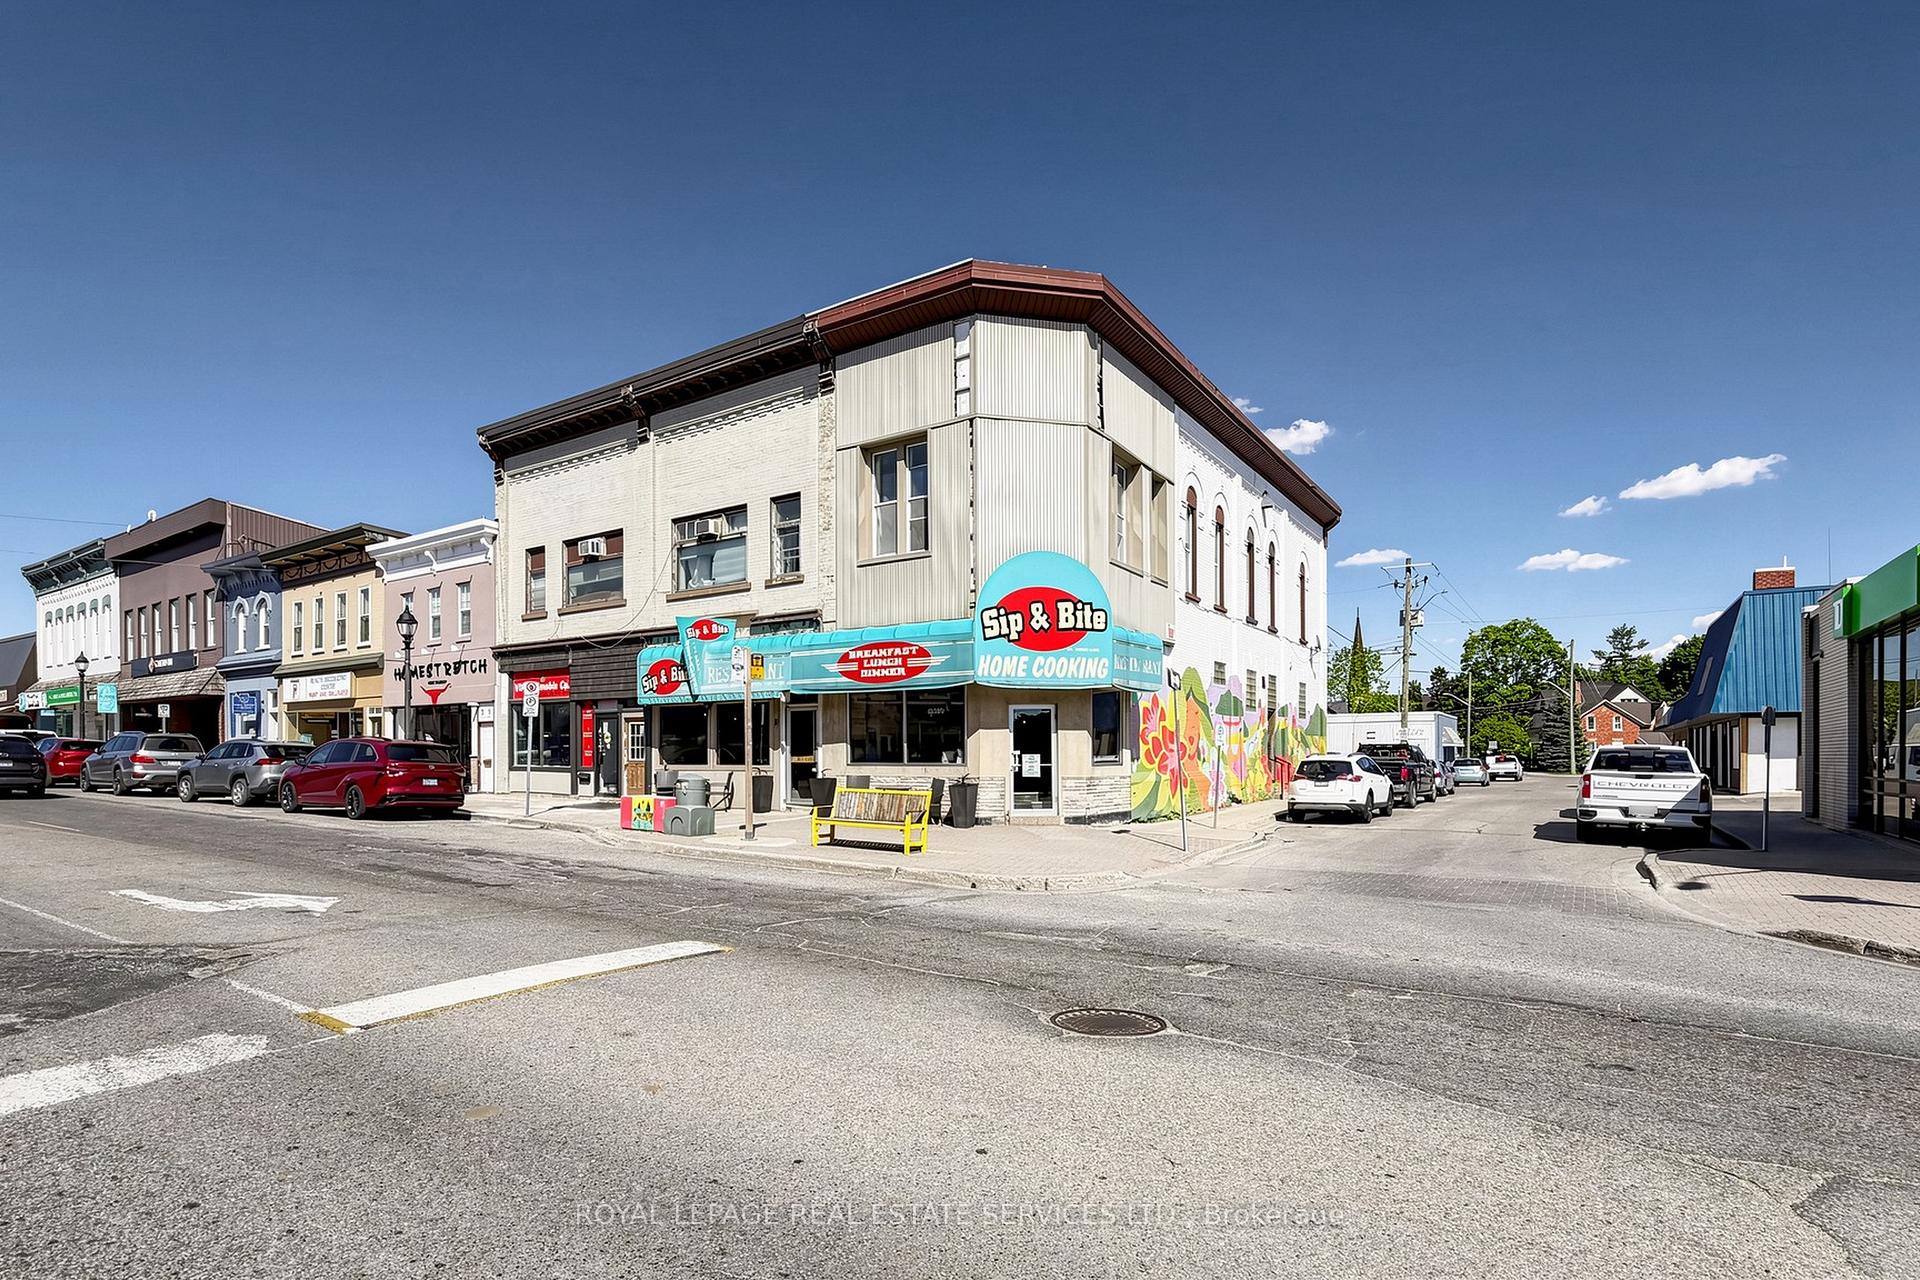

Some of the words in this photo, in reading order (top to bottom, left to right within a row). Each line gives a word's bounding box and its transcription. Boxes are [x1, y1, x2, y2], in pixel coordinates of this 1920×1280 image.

[981, 607, 1024, 642] Sip
[1029, 601, 1052, 633] &
[1056, 598, 1107, 632] Bite
[685, 626, 701, 639] Sip
[848, 646, 919, 659] BREAKFAST
[863, 658, 902, 667] LUNCH
[977, 654, 1029, 678] HOME
[1032, 656, 1109, 679] COOKING
[861, 667, 906, 678] DINNER
[641, 673, 659, 694] Sip
[660, 669, 668, 685] &
[1598, 781, 1693, 790] CHEVROLET
